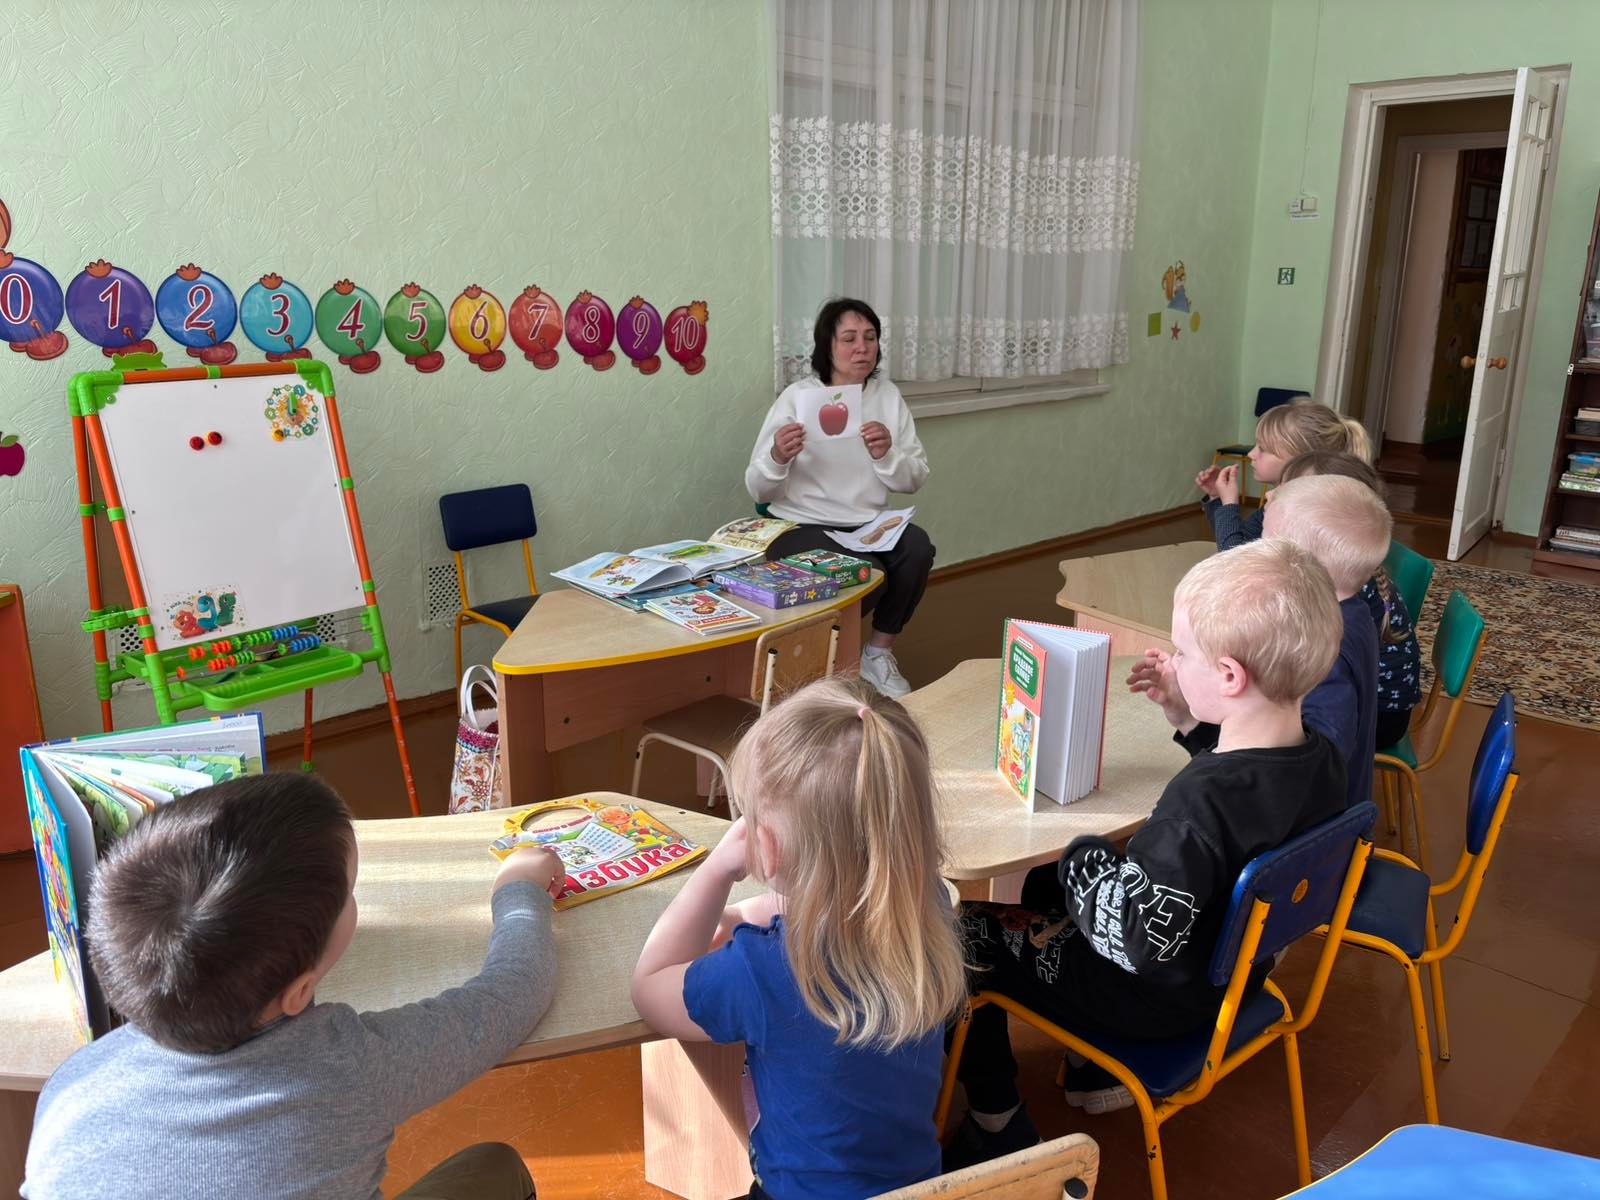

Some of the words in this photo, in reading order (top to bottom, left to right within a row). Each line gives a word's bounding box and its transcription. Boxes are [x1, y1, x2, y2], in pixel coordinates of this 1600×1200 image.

[0, 273, 33, 325] 0
[99, 279, 121, 329] 1
[184, 284, 215, 331] 2
[266, 293, 291, 336] 3
[336, 298, 365, 339] 4
[406, 300, 428, 341] 5
[469, 300, 490, 341] 6
[528, 303, 549, 340] 7
[582, 306, 600, 343] 8
[632, 311, 649, 349] 9
[671, 315, 700, 352] 10
